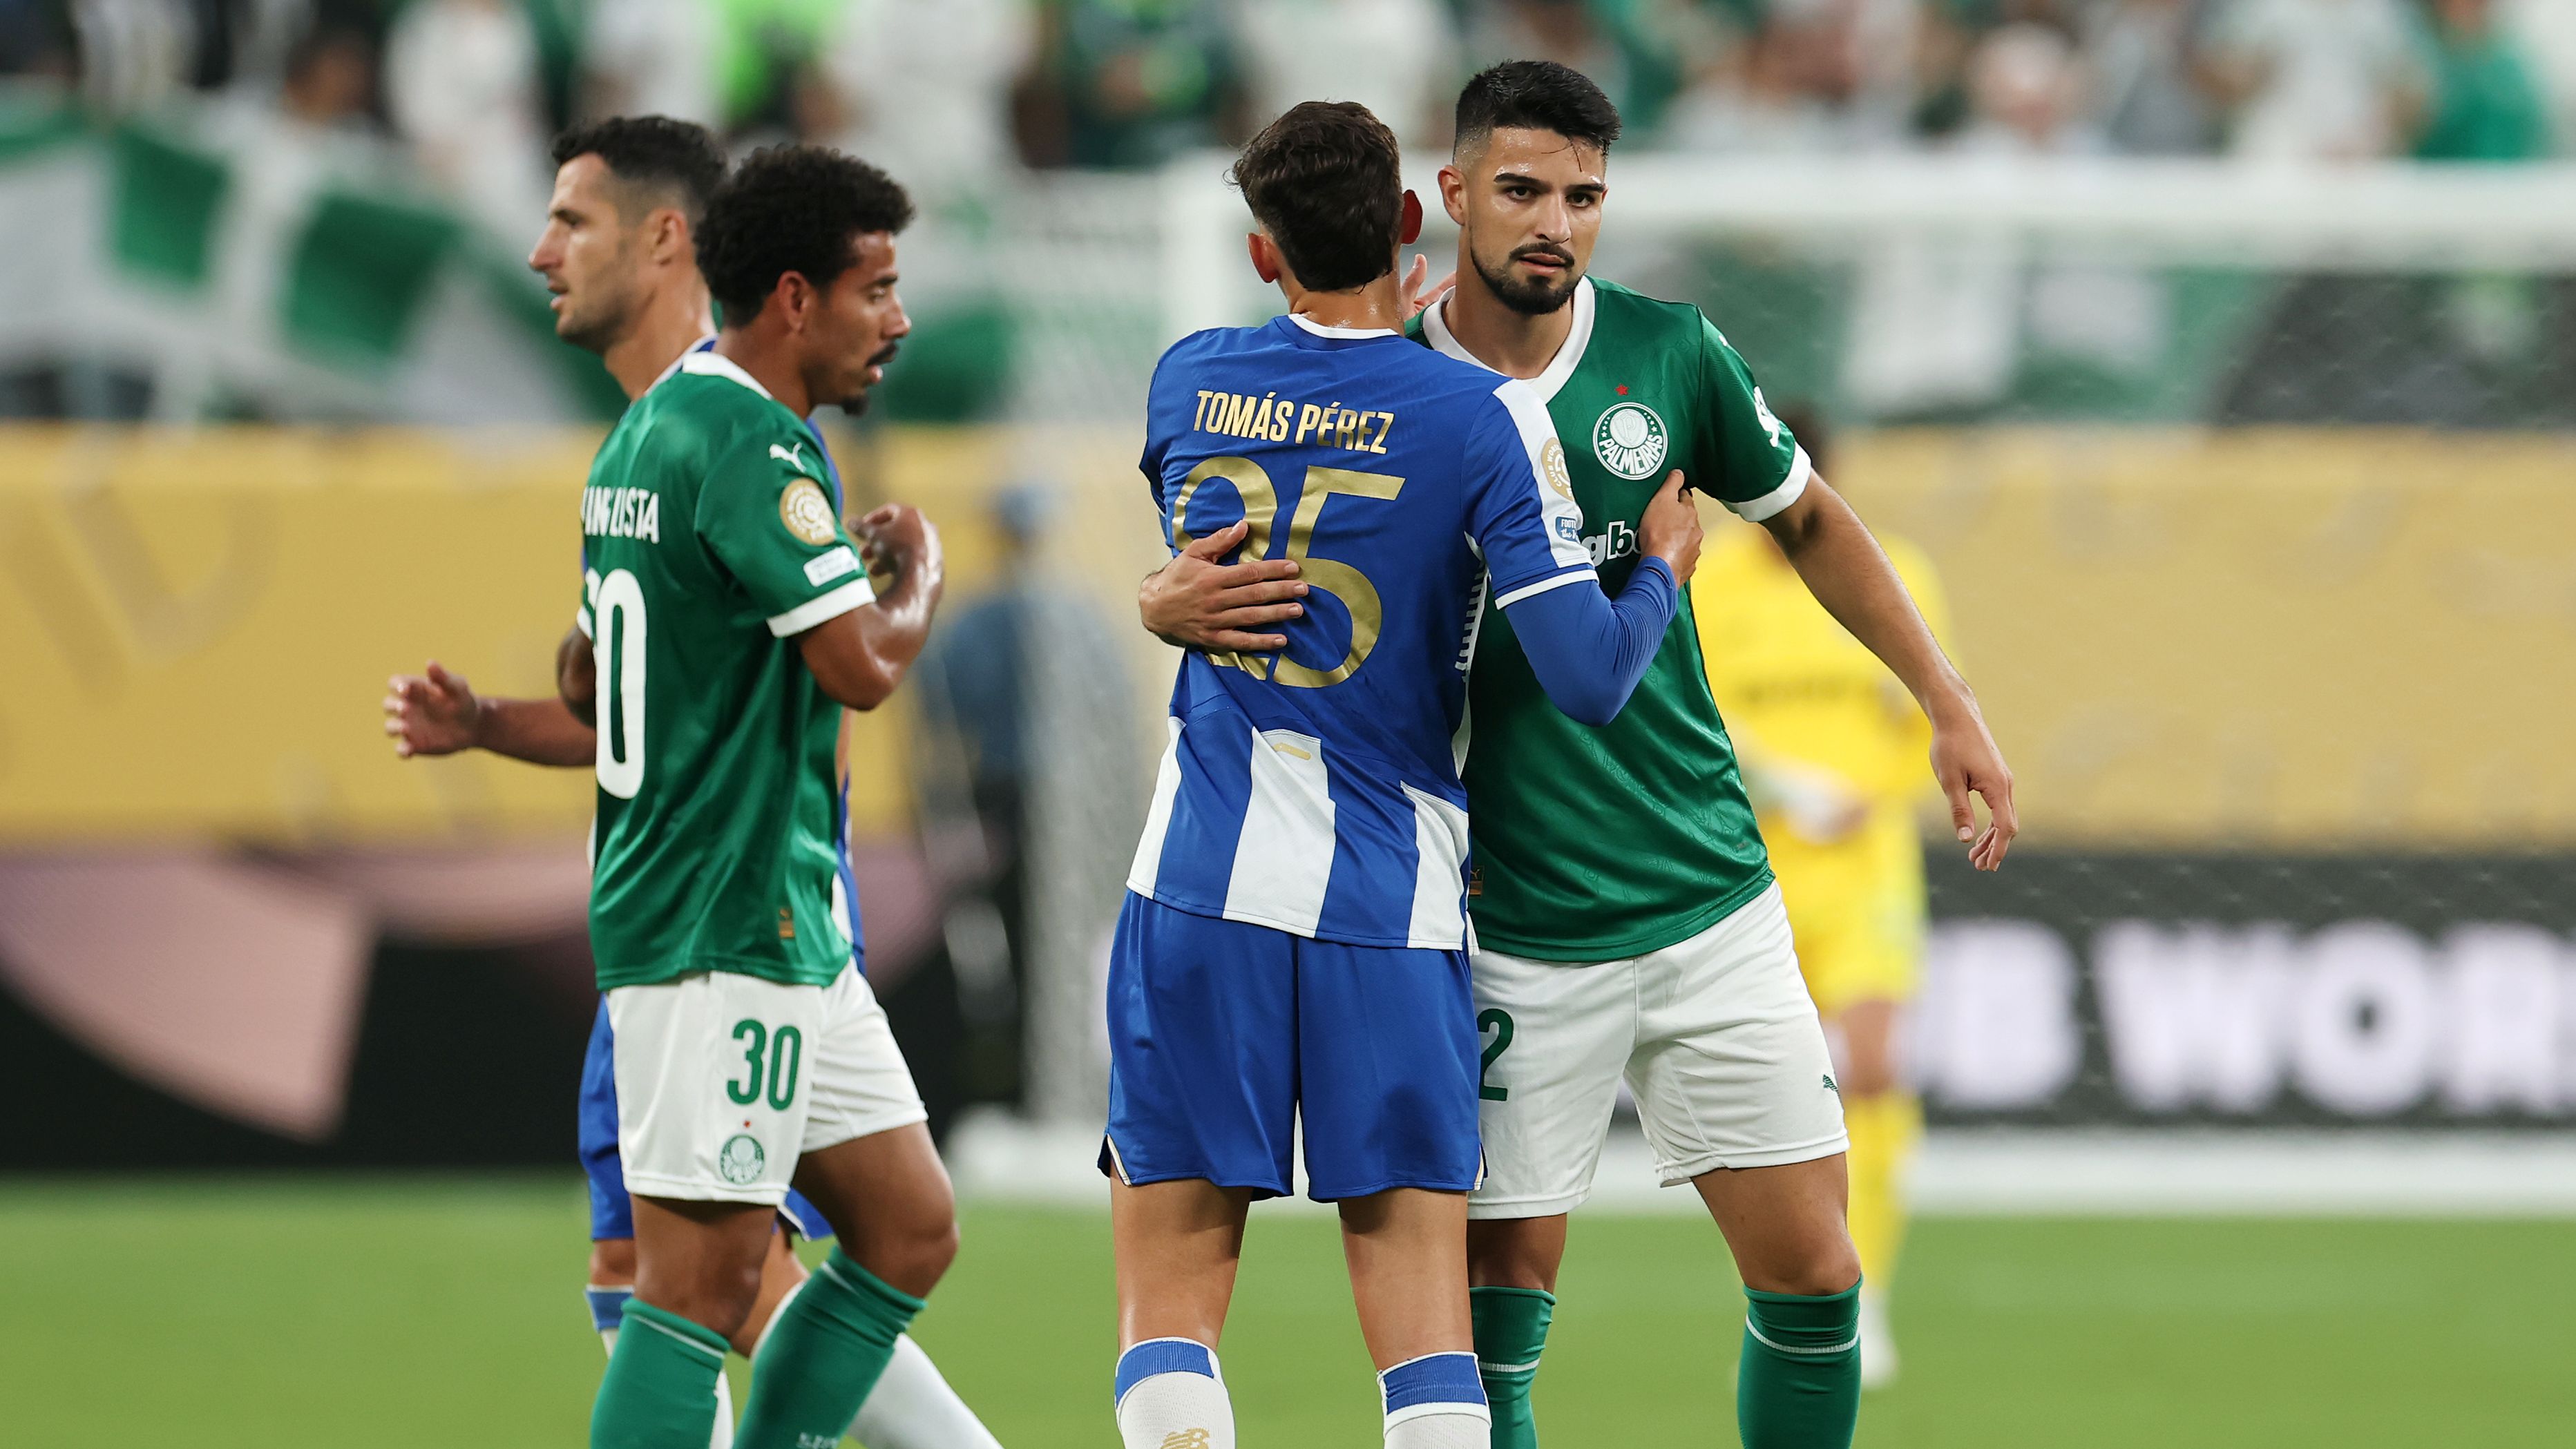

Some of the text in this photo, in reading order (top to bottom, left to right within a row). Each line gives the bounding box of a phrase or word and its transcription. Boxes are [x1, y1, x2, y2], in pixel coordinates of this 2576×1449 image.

[1194, 390, 1394, 454] TOMÁS PÉREZ
[1599, 434, 1663, 475] PALMEIRAS
[2097, 920, 2576, 1111] WOR
[727, 1019, 801, 1111] 30
